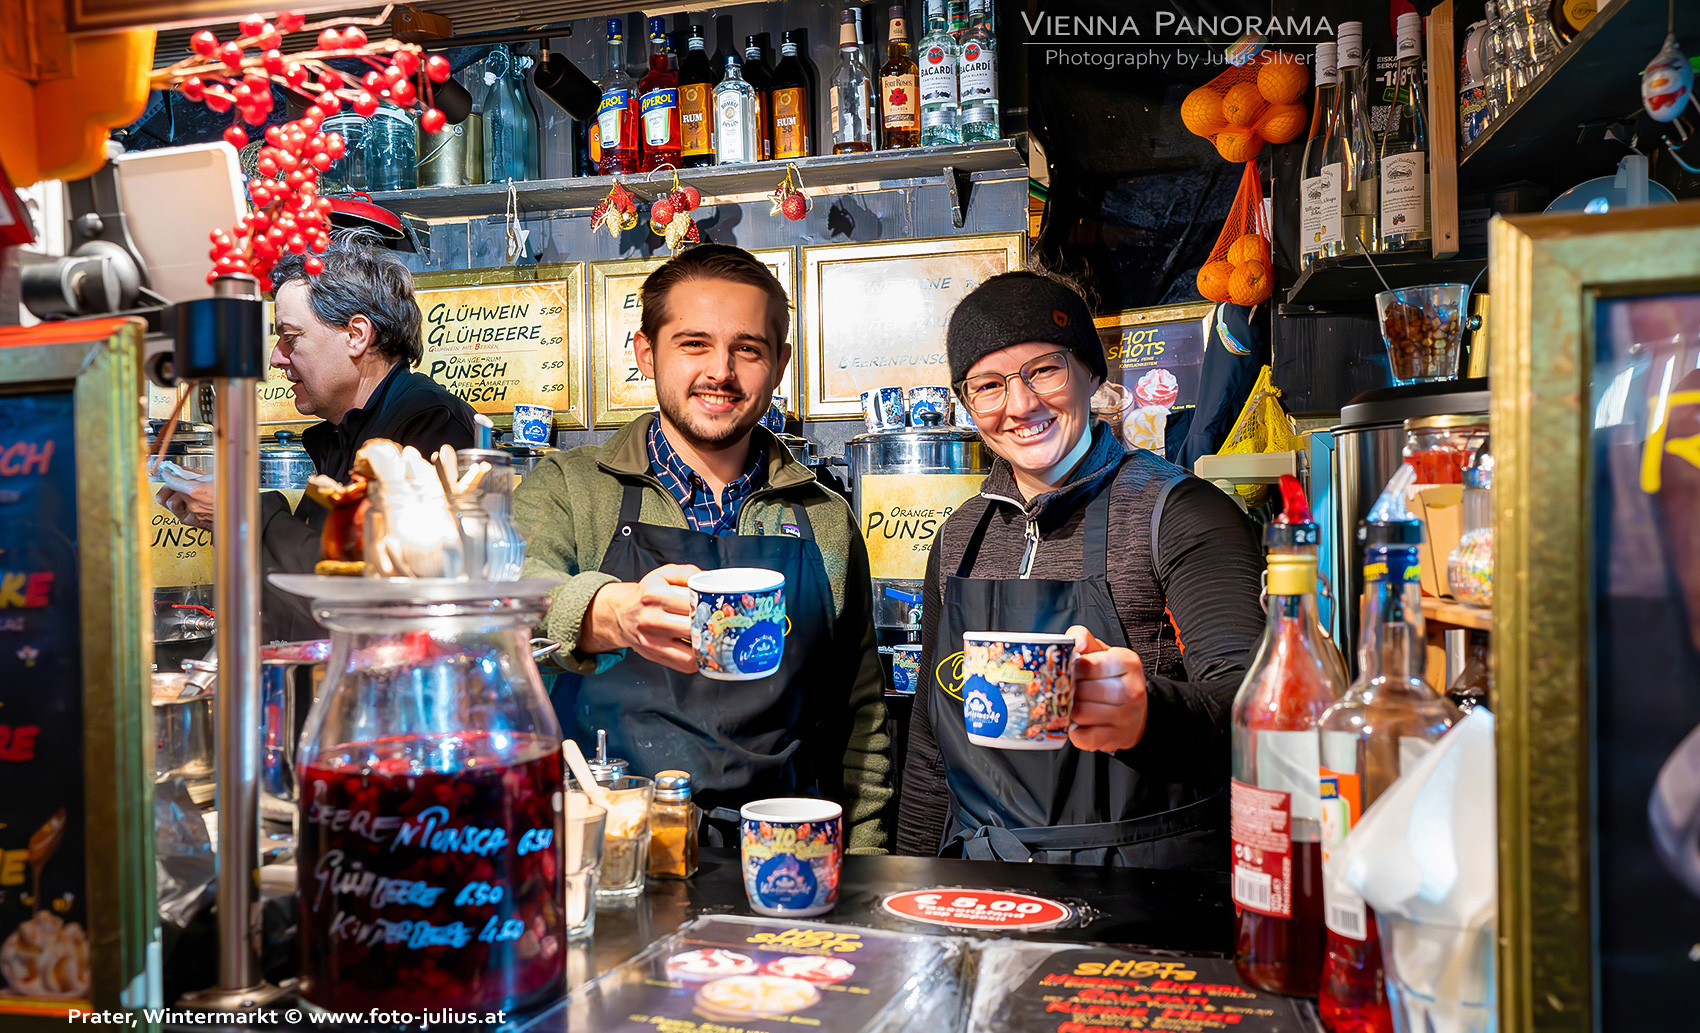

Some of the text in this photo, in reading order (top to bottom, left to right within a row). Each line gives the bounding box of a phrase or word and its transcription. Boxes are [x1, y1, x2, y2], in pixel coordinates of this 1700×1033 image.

[921, 65, 954, 77] BACARDÍ
[641, 93, 674, 112] APEROL
[682, 113, 703, 123] RUM
[776, 116, 797, 127] RUM
[427, 303, 563, 326] GLÜHWEIN 5,50
[427, 324, 563, 347] GLÜHBEERE 6,50
[1119, 328, 1159, 346] HOT
[1107, 341, 1166, 360] SHOTS
[838, 352, 950, 370] BEERENPUNSC
[429, 360, 564, 380] PUNSCH 5,50
[449, 379, 521, 389] APFEL-AMARETTO
[541, 383, 565, 393] 5,50
[153, 395, 171, 405] 3,50
[890, 506, 953, 518] ORANGE-R
[866, 511, 937, 540] PUNS
[176, 550, 197, 560] 5,50
